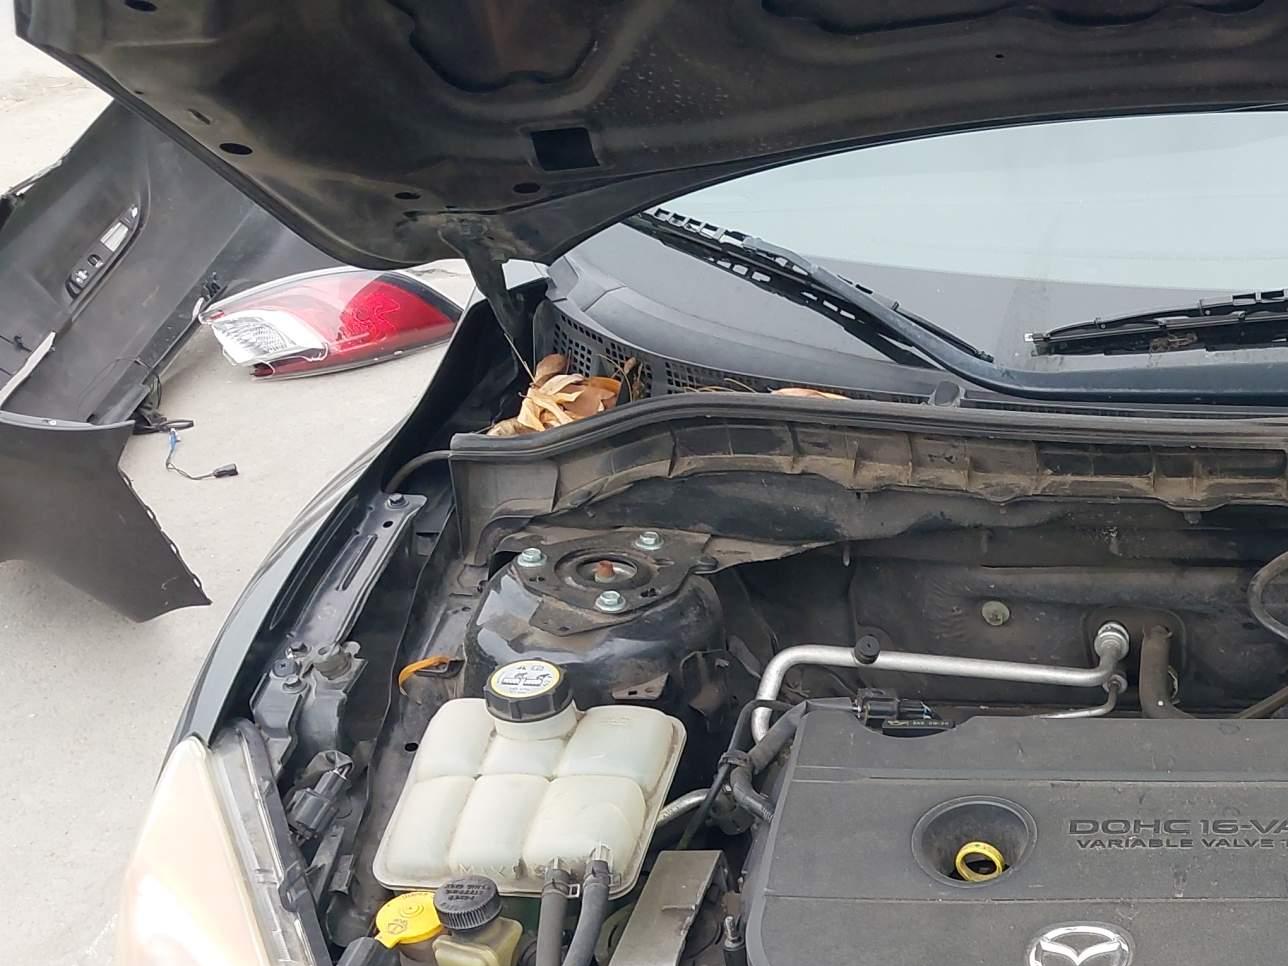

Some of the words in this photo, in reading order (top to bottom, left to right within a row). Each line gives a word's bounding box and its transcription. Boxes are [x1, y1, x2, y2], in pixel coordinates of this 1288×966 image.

[1069, 819, 1192, 835] DOHC
[1076, 838, 1194, 849] VARIABLE
[1201, 838, 1275, 848] VALVE
